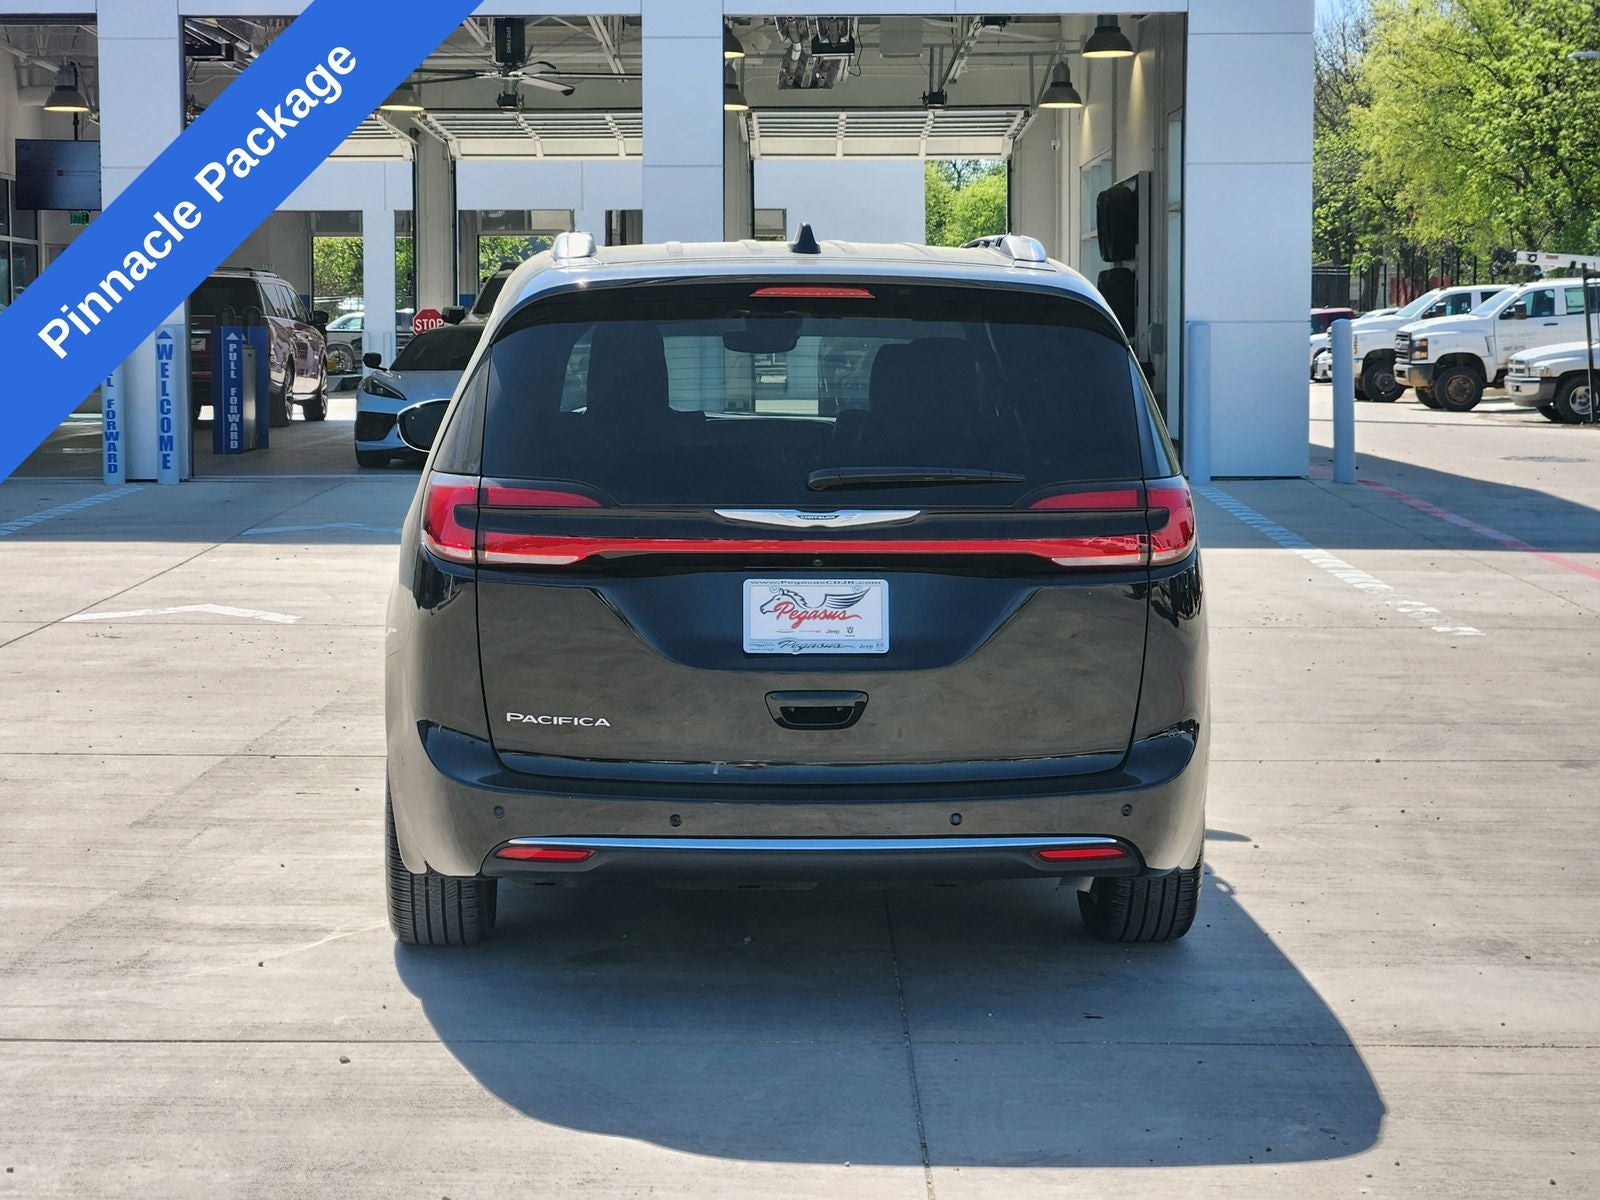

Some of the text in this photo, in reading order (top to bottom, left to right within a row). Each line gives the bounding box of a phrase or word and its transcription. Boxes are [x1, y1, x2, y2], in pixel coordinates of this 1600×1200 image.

[415, 318, 445, 331] STOP
[156, 343, 174, 470] WELCOME
[227, 343, 240, 449] PULL FORWARD
[105, 398, 119, 474] FORWARD
[773, 600, 863, 629] Pegasus
[506, 712, 612, 727] PACIFICA
